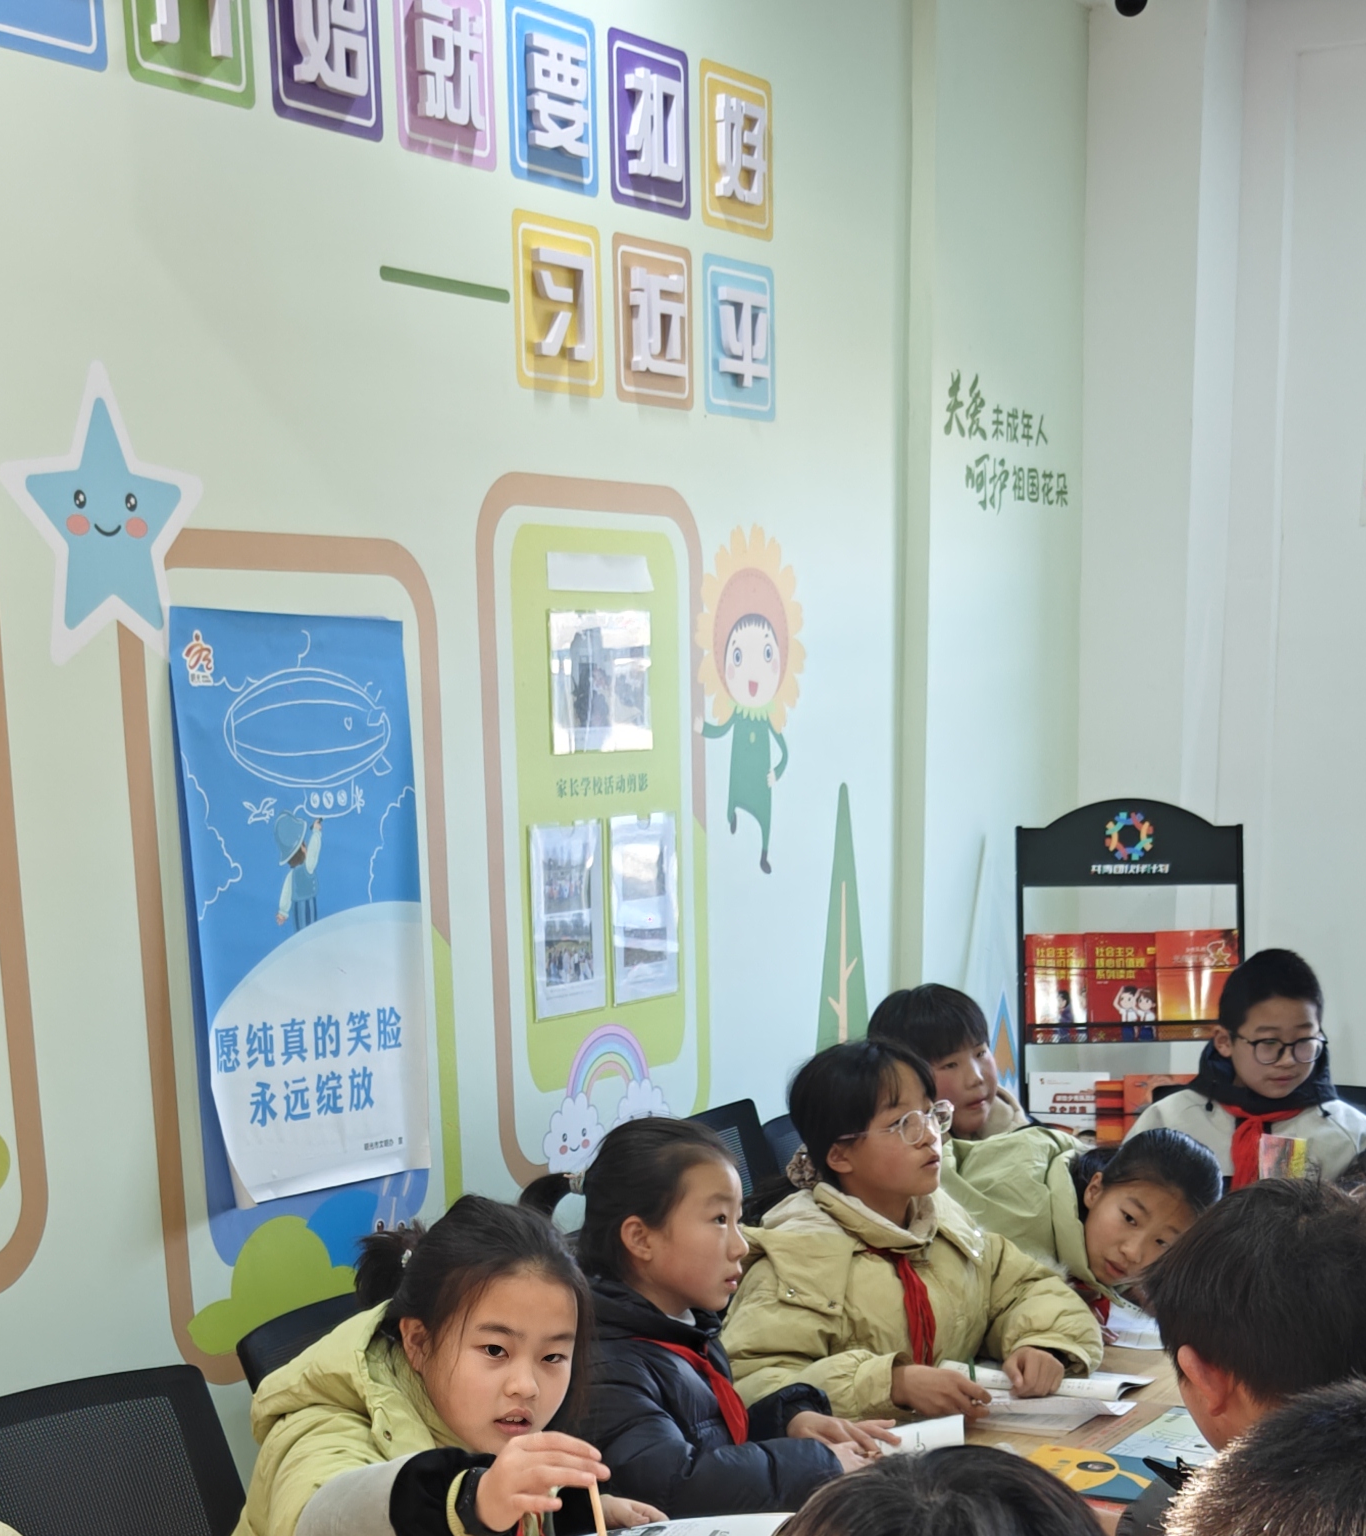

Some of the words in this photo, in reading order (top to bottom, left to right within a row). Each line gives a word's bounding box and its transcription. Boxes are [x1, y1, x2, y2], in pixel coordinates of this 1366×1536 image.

[531, 246, 771, 389] 习近平
[965, 453, 1069, 516] 呵护祖国花朵
[555, 773, 649, 799] 家长学校活动剪影
[214, 1006, 403, 1075] 愿纯真的笑脸
[249, 1066, 375, 1128] 永远绽放
